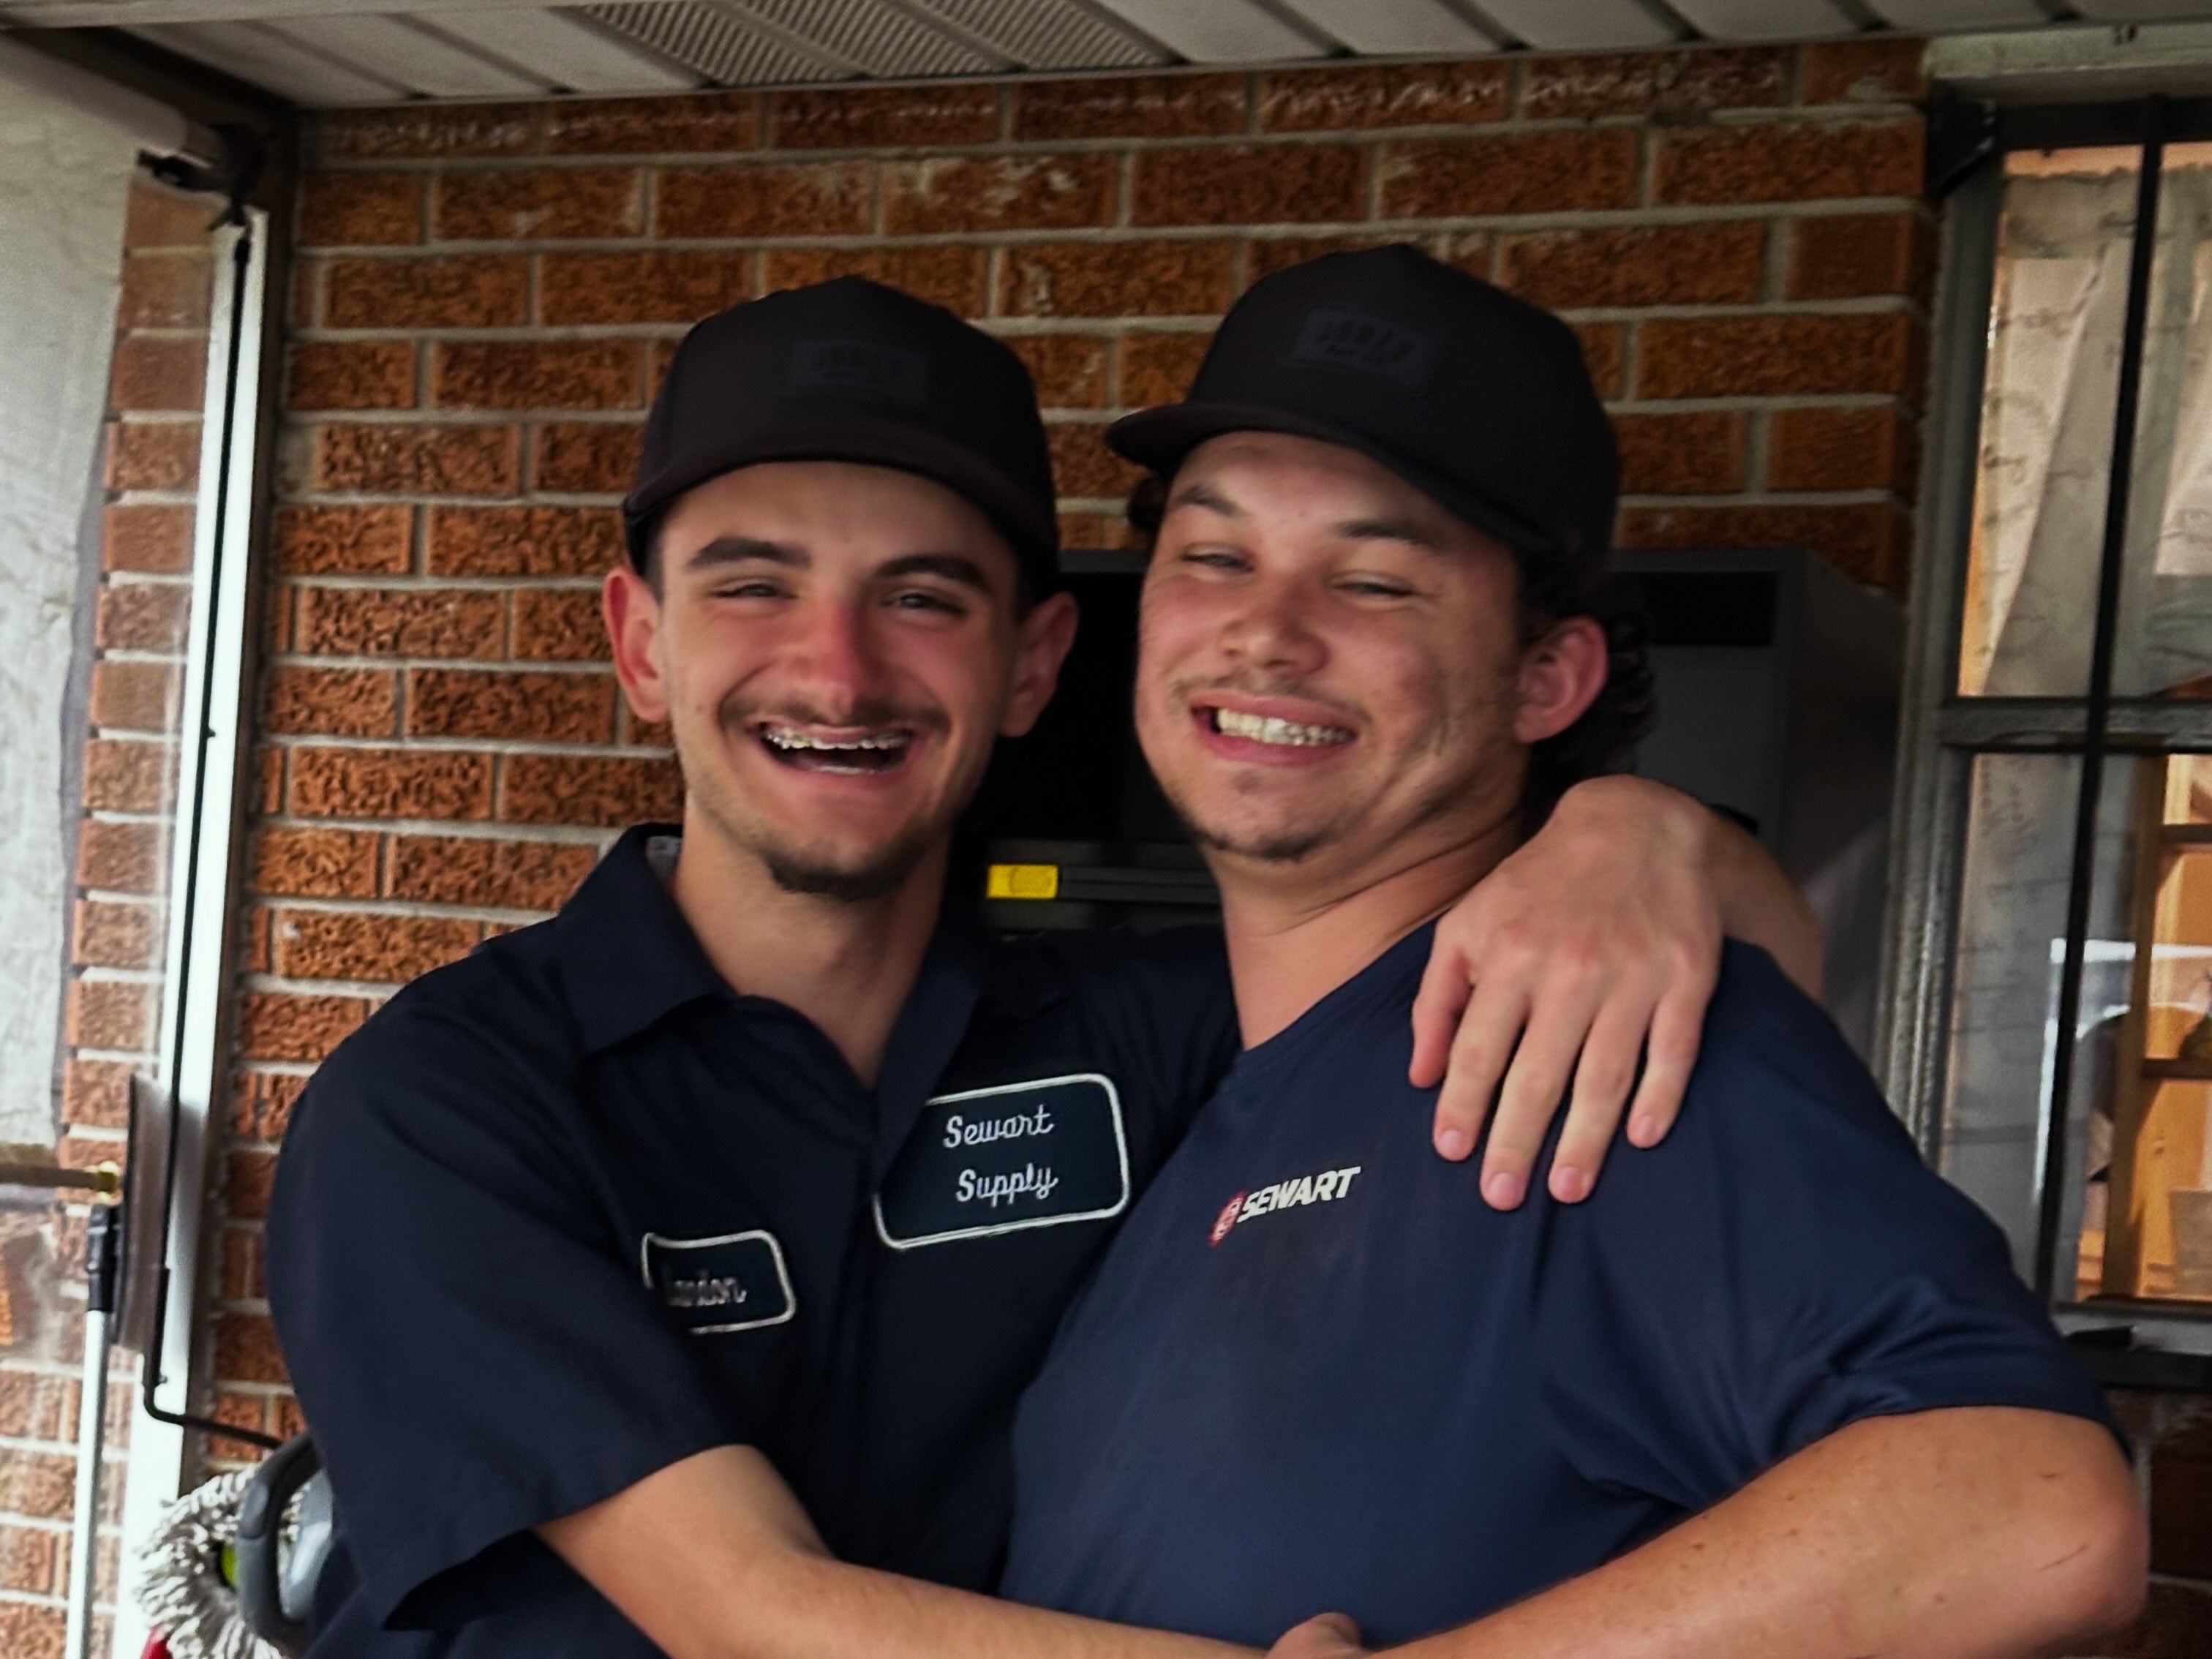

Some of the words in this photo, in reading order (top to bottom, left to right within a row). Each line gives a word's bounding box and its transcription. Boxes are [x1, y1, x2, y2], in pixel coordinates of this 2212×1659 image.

[943, 1103, 1055, 1148] Sewart
[955, 1162, 1059, 1208] Supply
[1236, 1166, 1361, 1223] SEWART
